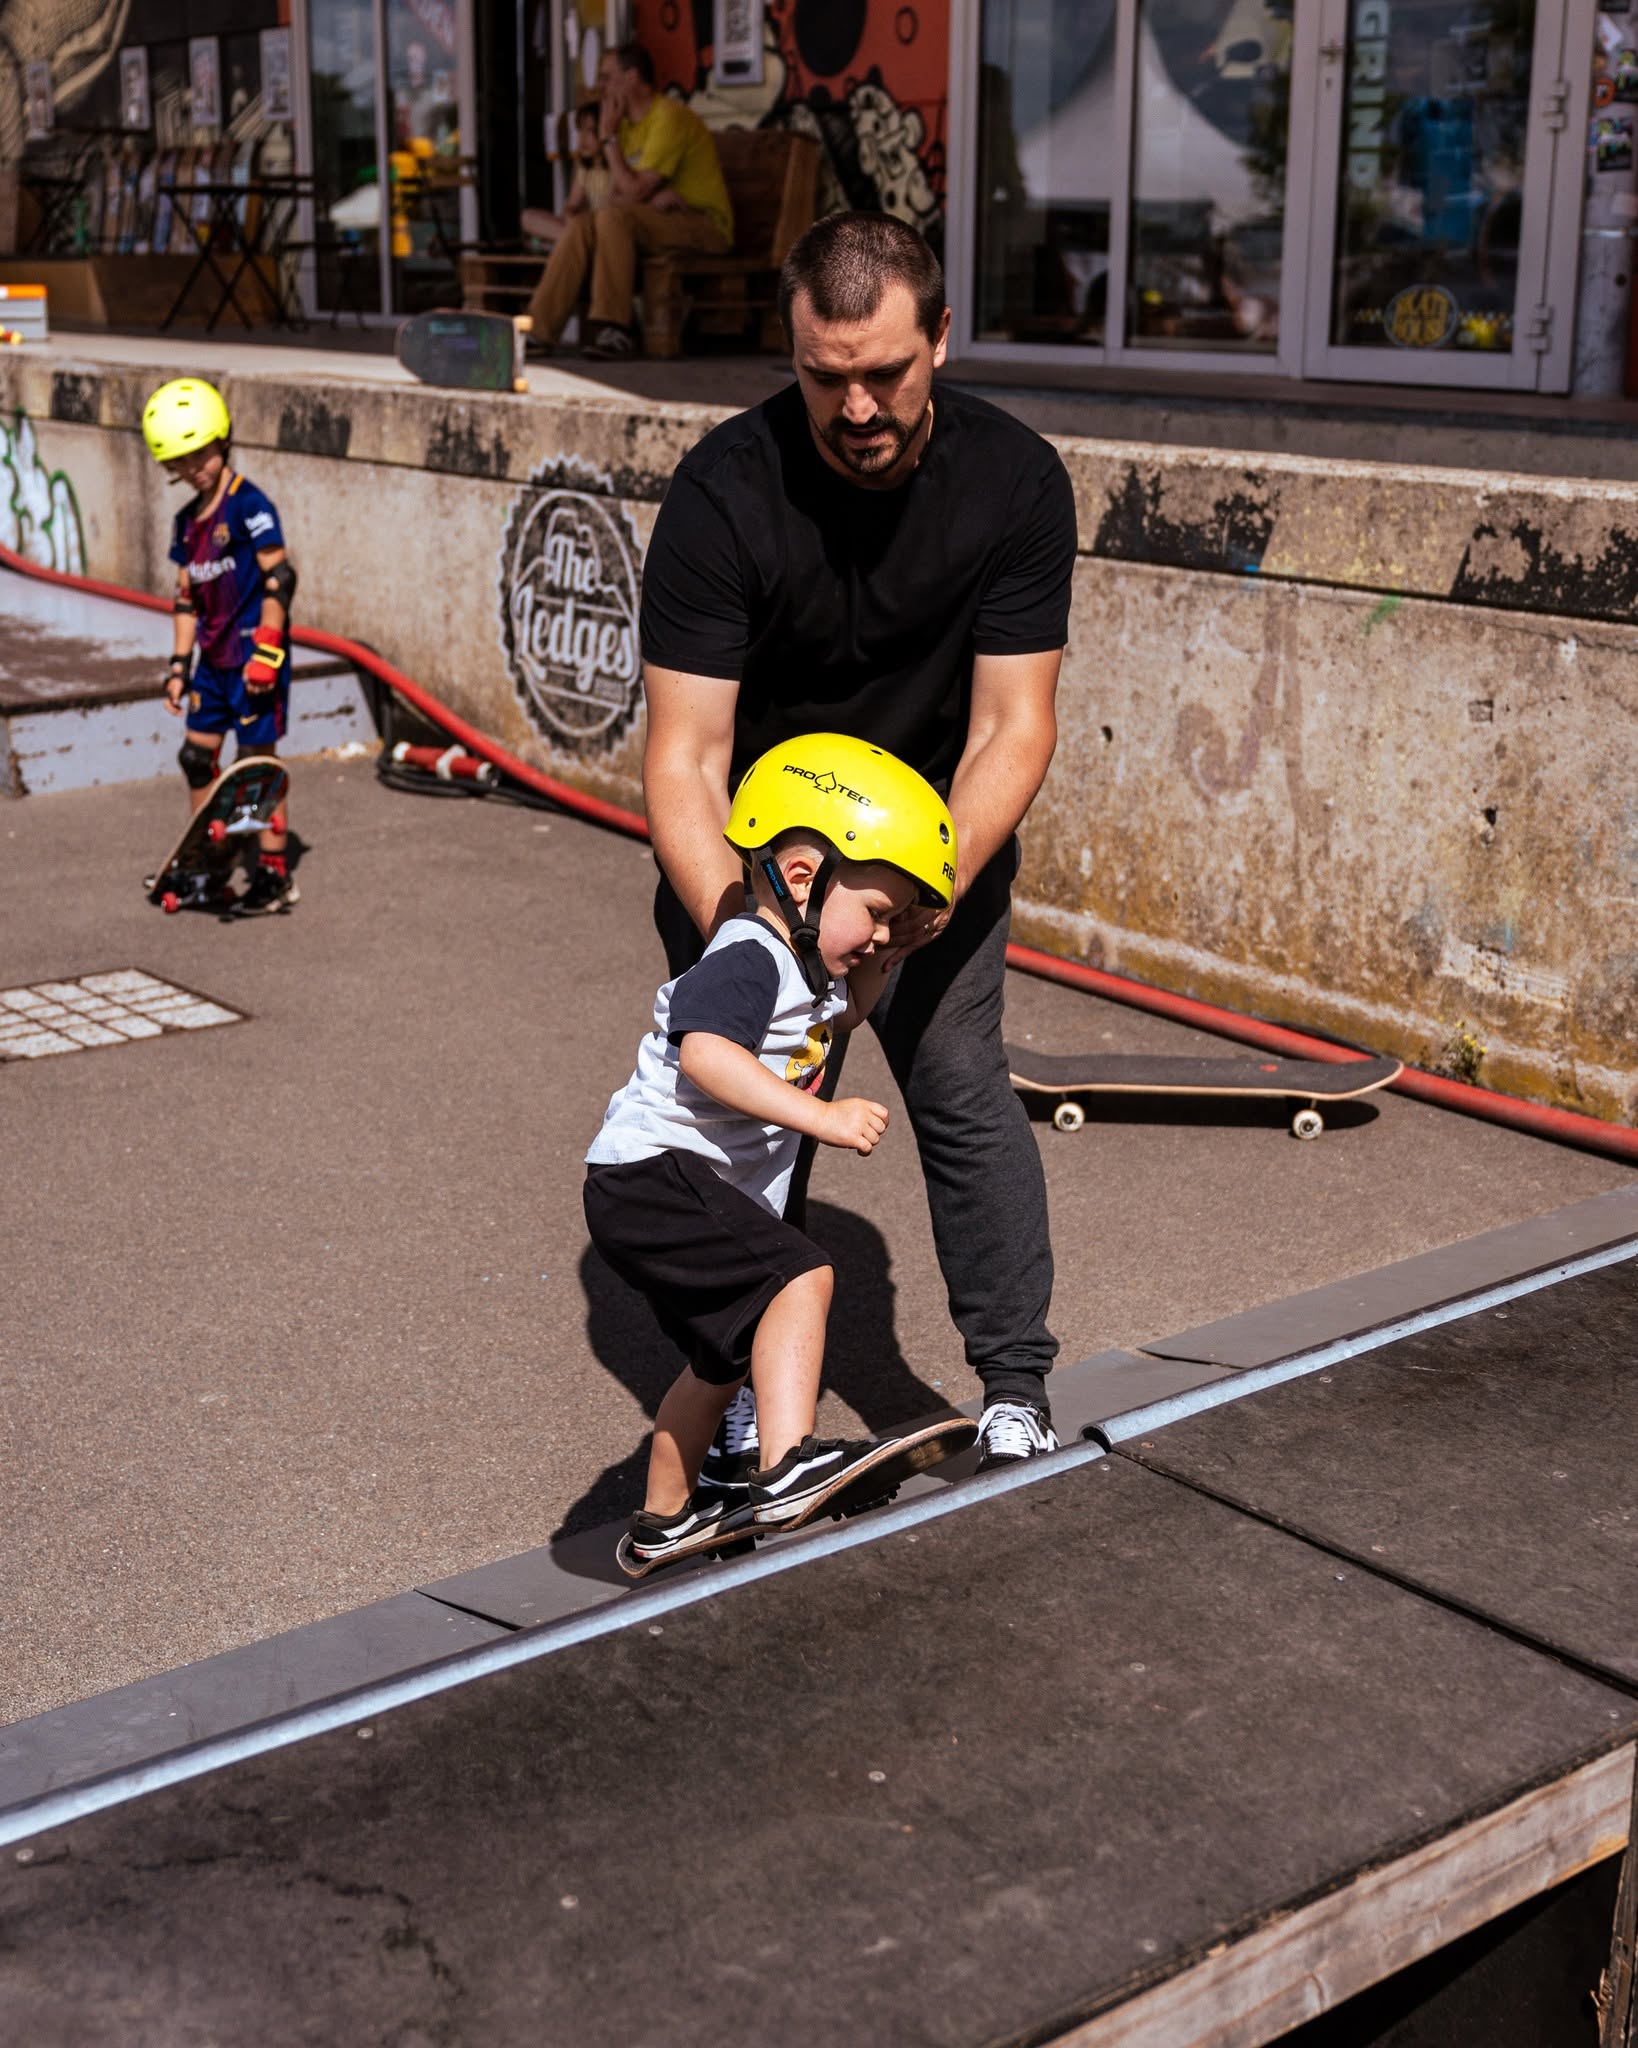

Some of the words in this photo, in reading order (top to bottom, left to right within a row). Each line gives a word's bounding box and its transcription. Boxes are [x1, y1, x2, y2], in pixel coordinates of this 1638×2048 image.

[1349, 0, 1390, 190] GRIND
[548, 534, 596, 593] The
[782, 764, 816, 781] PRO
[837, 783, 872, 807] TEC
